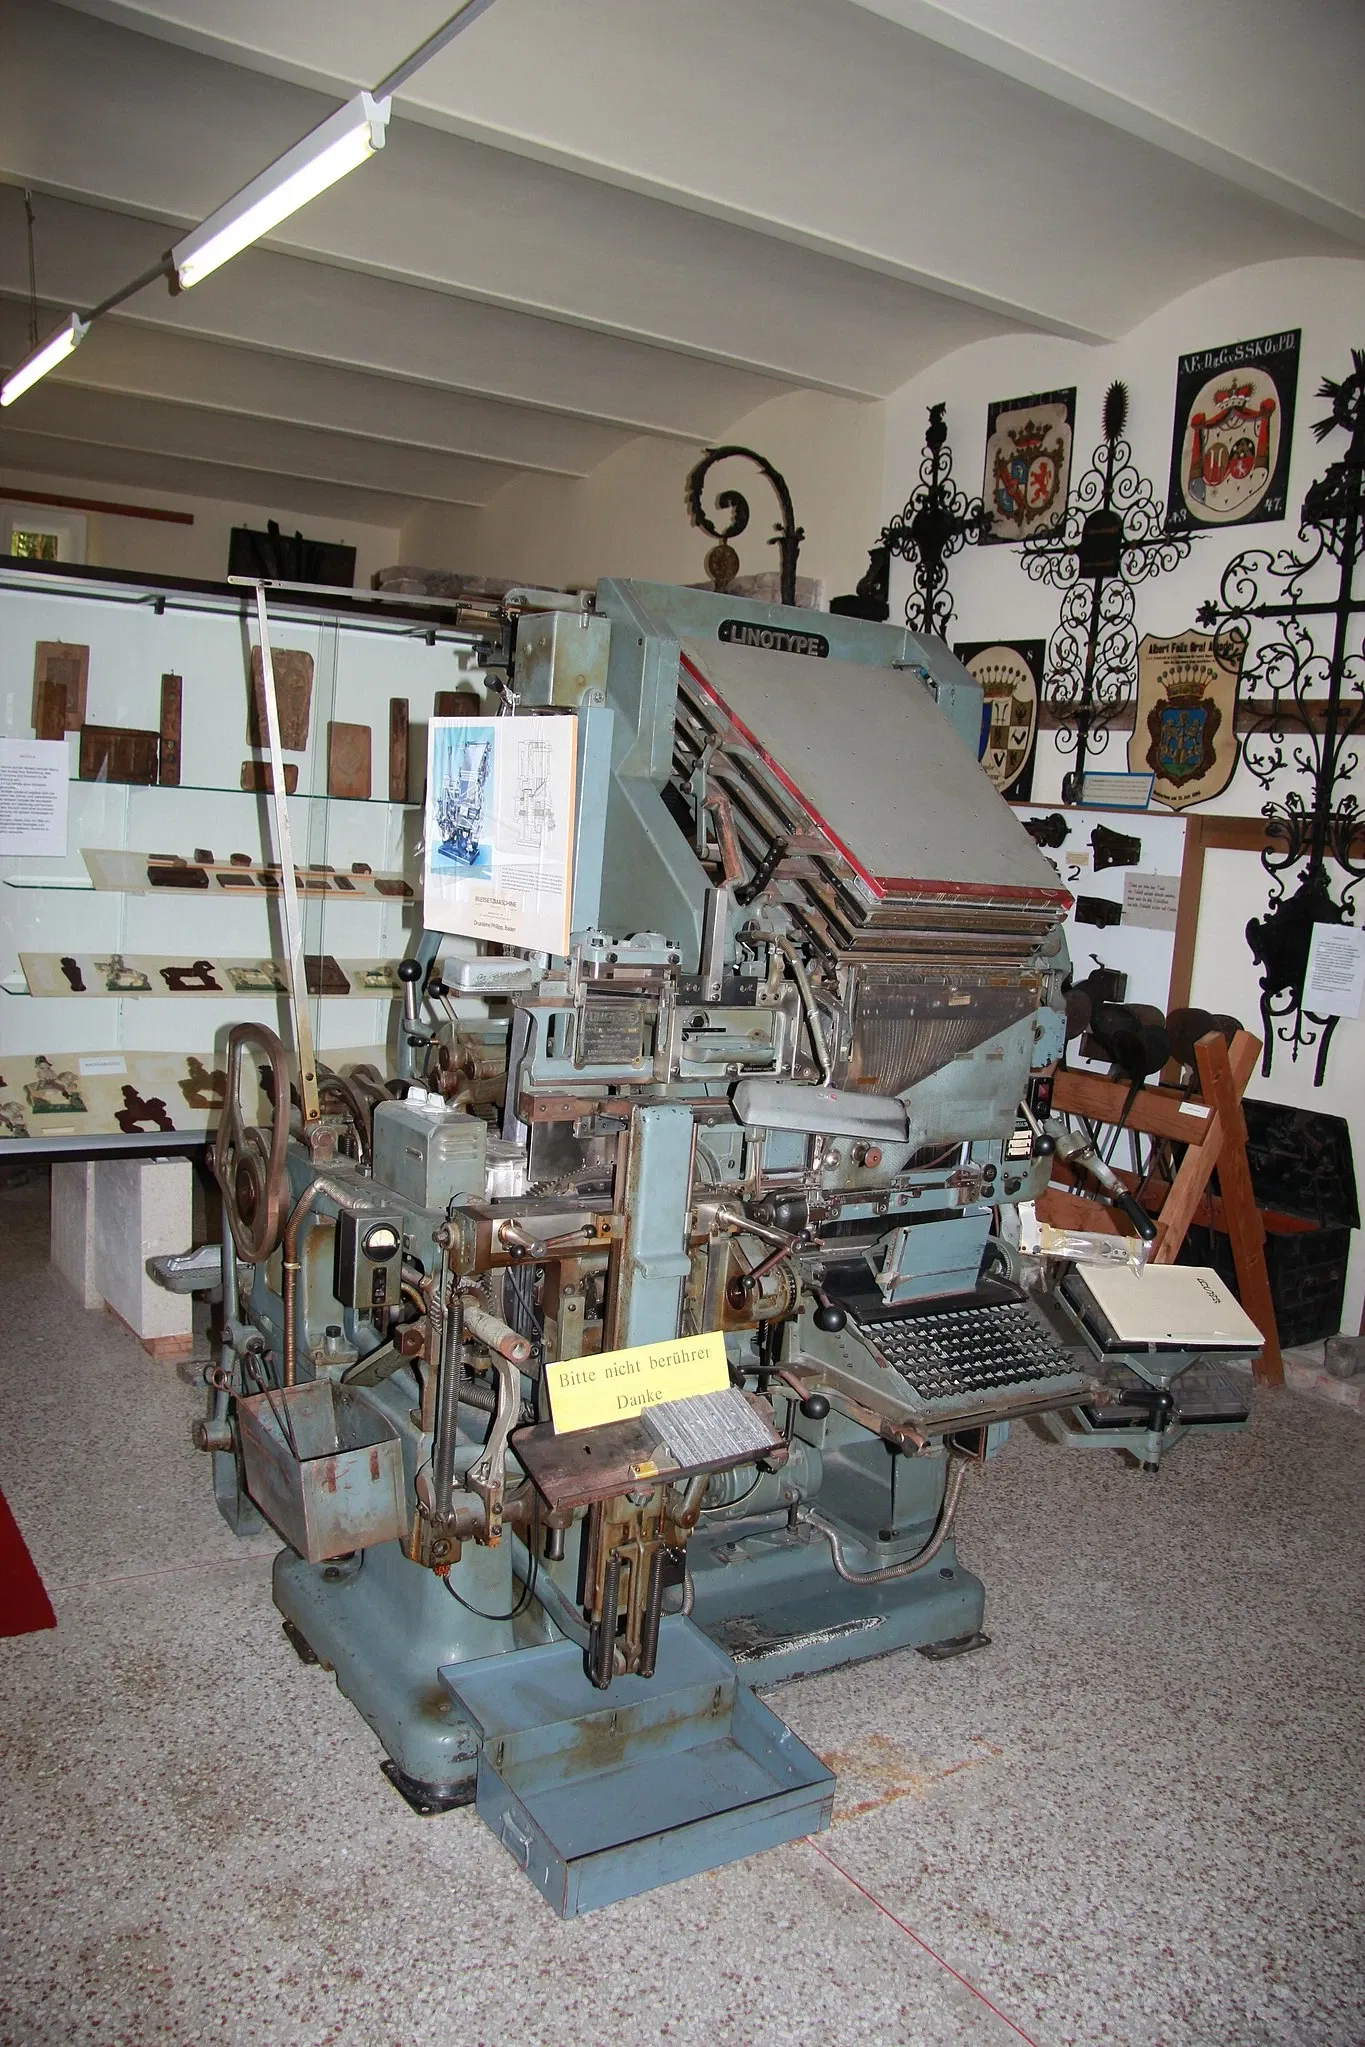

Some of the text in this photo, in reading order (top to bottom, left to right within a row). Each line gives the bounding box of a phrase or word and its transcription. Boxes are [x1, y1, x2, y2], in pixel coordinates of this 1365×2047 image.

[730, 624, 819, 656] LINOTYPE
[1148, 643, 1169, 655] Albert
[1190, 641, 1206, 653] Graf
[1067, 865, 1081, 882] 2
[559, 1370, 597, 1388] Bitte
[604, 1360, 641, 1379] nicht
[616, 1388, 663, 1410] Danke
